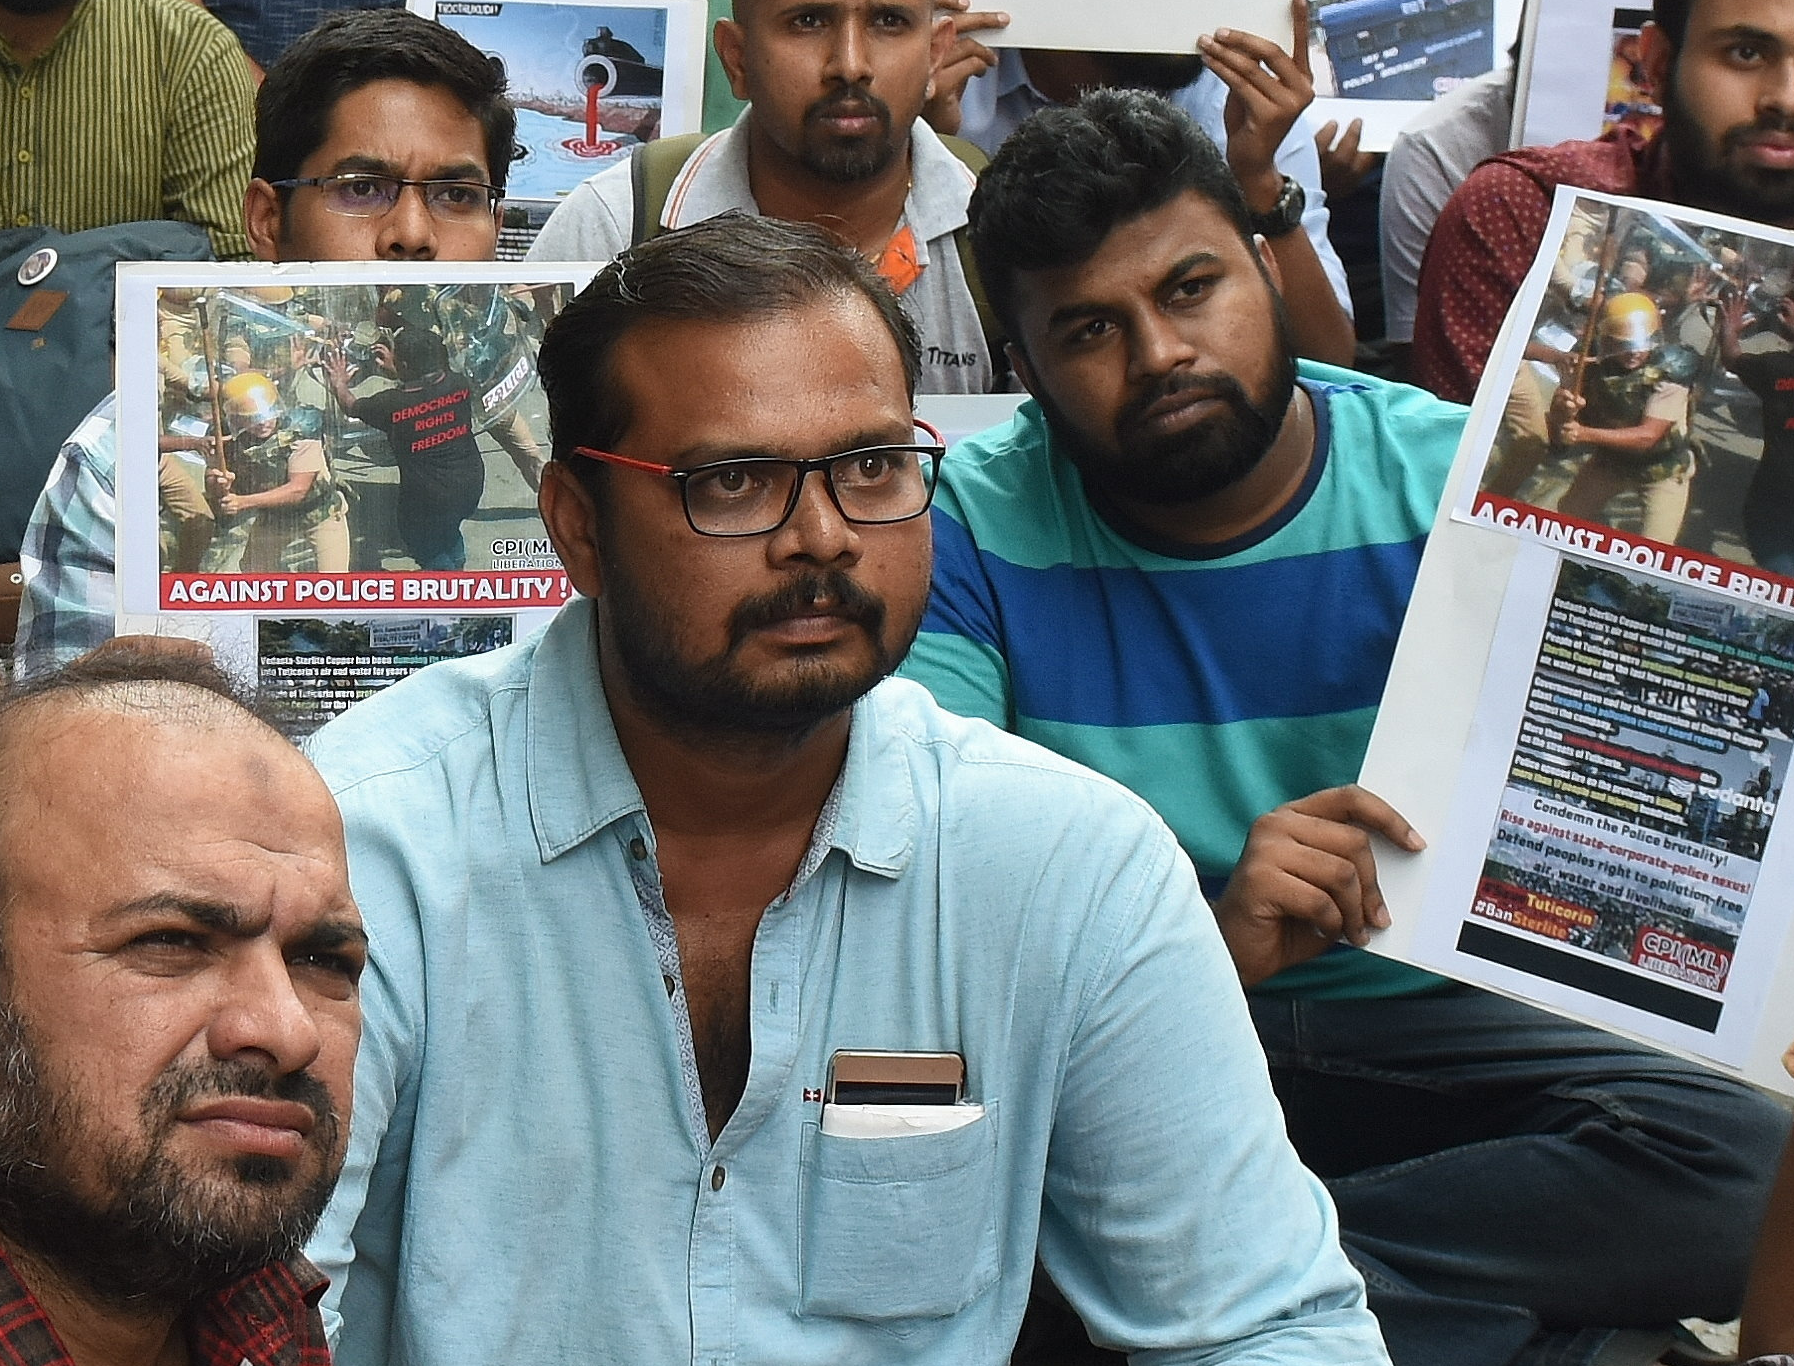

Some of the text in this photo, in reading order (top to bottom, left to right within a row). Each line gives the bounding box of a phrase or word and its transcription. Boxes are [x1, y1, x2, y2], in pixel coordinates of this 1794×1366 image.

[928, 347, 976, 367] TITANS
[482, 356, 529, 412] POLICE
[392, 388, 469, 423] DEMOCRACY
[415, 411, 456, 432] RIGHTS
[411, 424, 469, 453] FREEDOM
[1471, 500, 1609, 555] AGAINST
[1601, 538, 1722, 590] POLICE
[493, 559, 563, 569] LIBERATION
[169, 577, 567, 603] AGAINST POLICE BRUTALITY !
[349, 668, 372, 676] water
[373, 667, 384, 675] for
[386, 668, 408, 676] years
[372, 656, 392, 664] been
[333, 700, 346, 708] the
[1698, 785, 1775, 815] vedanta
[1531, 798, 1729, 871] Condemn the Police brutality!
[1499, 808, 1751, 895] Rise against state-corporate-police nexus!
[1496, 828, 1745, 914] Defend peoples right to pollution-free
[1531, 860, 1696, 920] air, water and livelihood!
[1473, 898, 1570, 940] #BanSterlite
[1637, 929, 1732, 981] CPI(ML)
